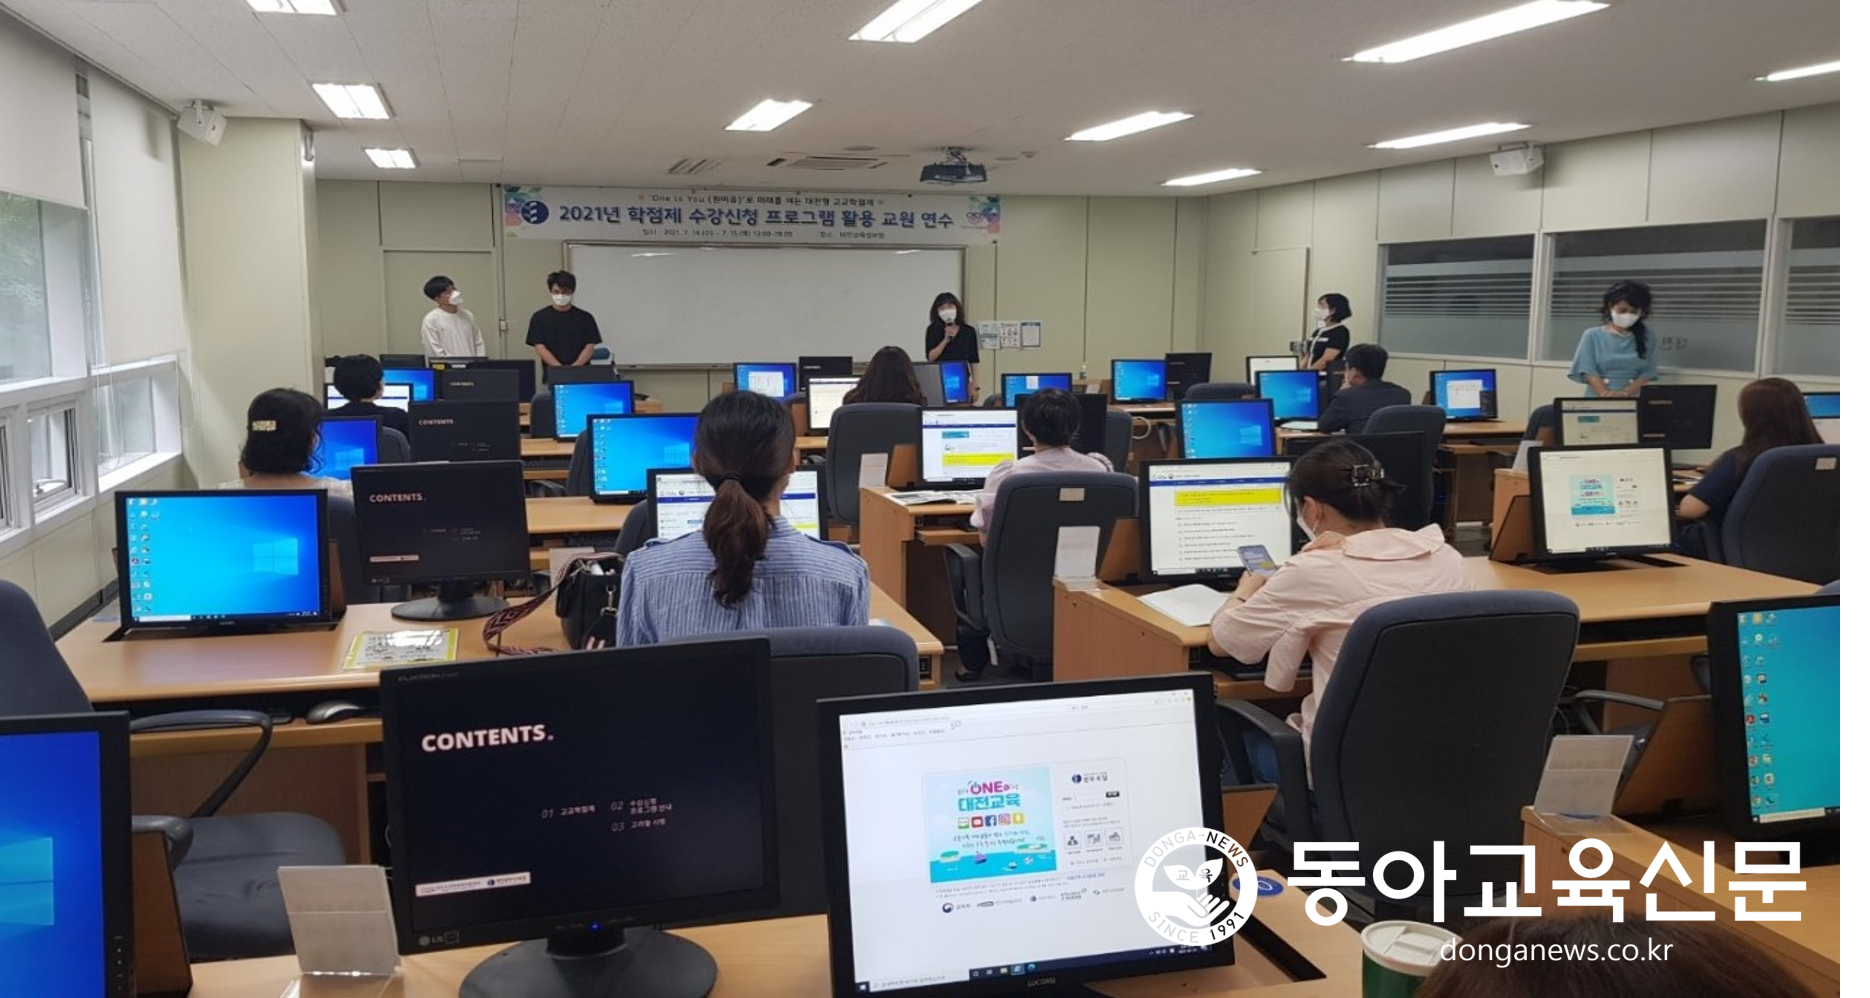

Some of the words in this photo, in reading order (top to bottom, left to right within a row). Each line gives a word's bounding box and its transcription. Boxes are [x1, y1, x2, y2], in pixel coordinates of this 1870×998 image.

[559, 205, 621, 224] 2021년
[627, 206, 682, 225] 학점제
[688, 208, 759, 226] 수강신청
[765, 210, 835, 227] 프로그램
[841, 210, 875, 228] 활용
[881, 212, 915, 229] 교원
[921, 213, 954, 229] 연수
[421, 724, 554, 752] CONTENTS.
[610, 801, 624, 811] 02
[958, 792, 1021, 812] 대전교육
[541, 809, 554, 818] 01
[611, 822, 625, 832] 03
